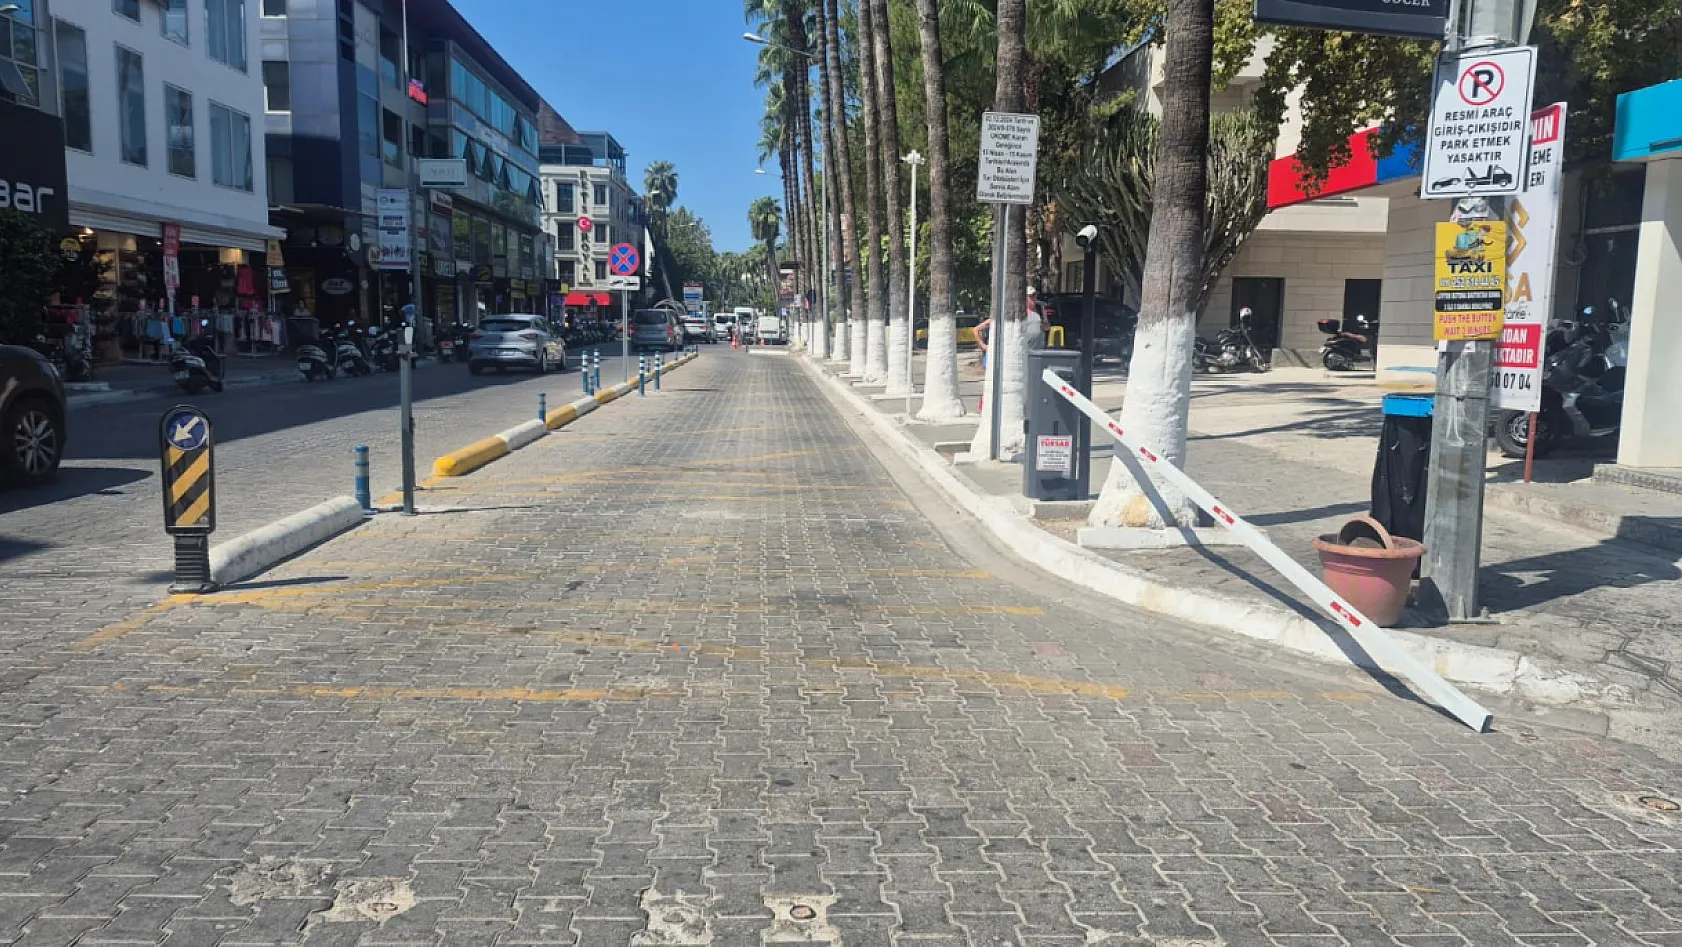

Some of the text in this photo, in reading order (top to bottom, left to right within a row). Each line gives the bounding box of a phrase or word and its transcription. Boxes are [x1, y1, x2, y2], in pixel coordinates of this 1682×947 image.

[1445, 106, 1513, 121] RESMİ ARAÇ
[1434, 120, 1522, 138] GİRİŞ-ÇIKIŞIDIR
[1440, 135, 1511, 150] PARK ETMEK
[1447, 151, 1502, 164] YASAKTIR
[1447, 261, 1493, 274] TAXI
[1503, 372, 1516, 389] 07
[1518, 373, 1531, 390] 04
